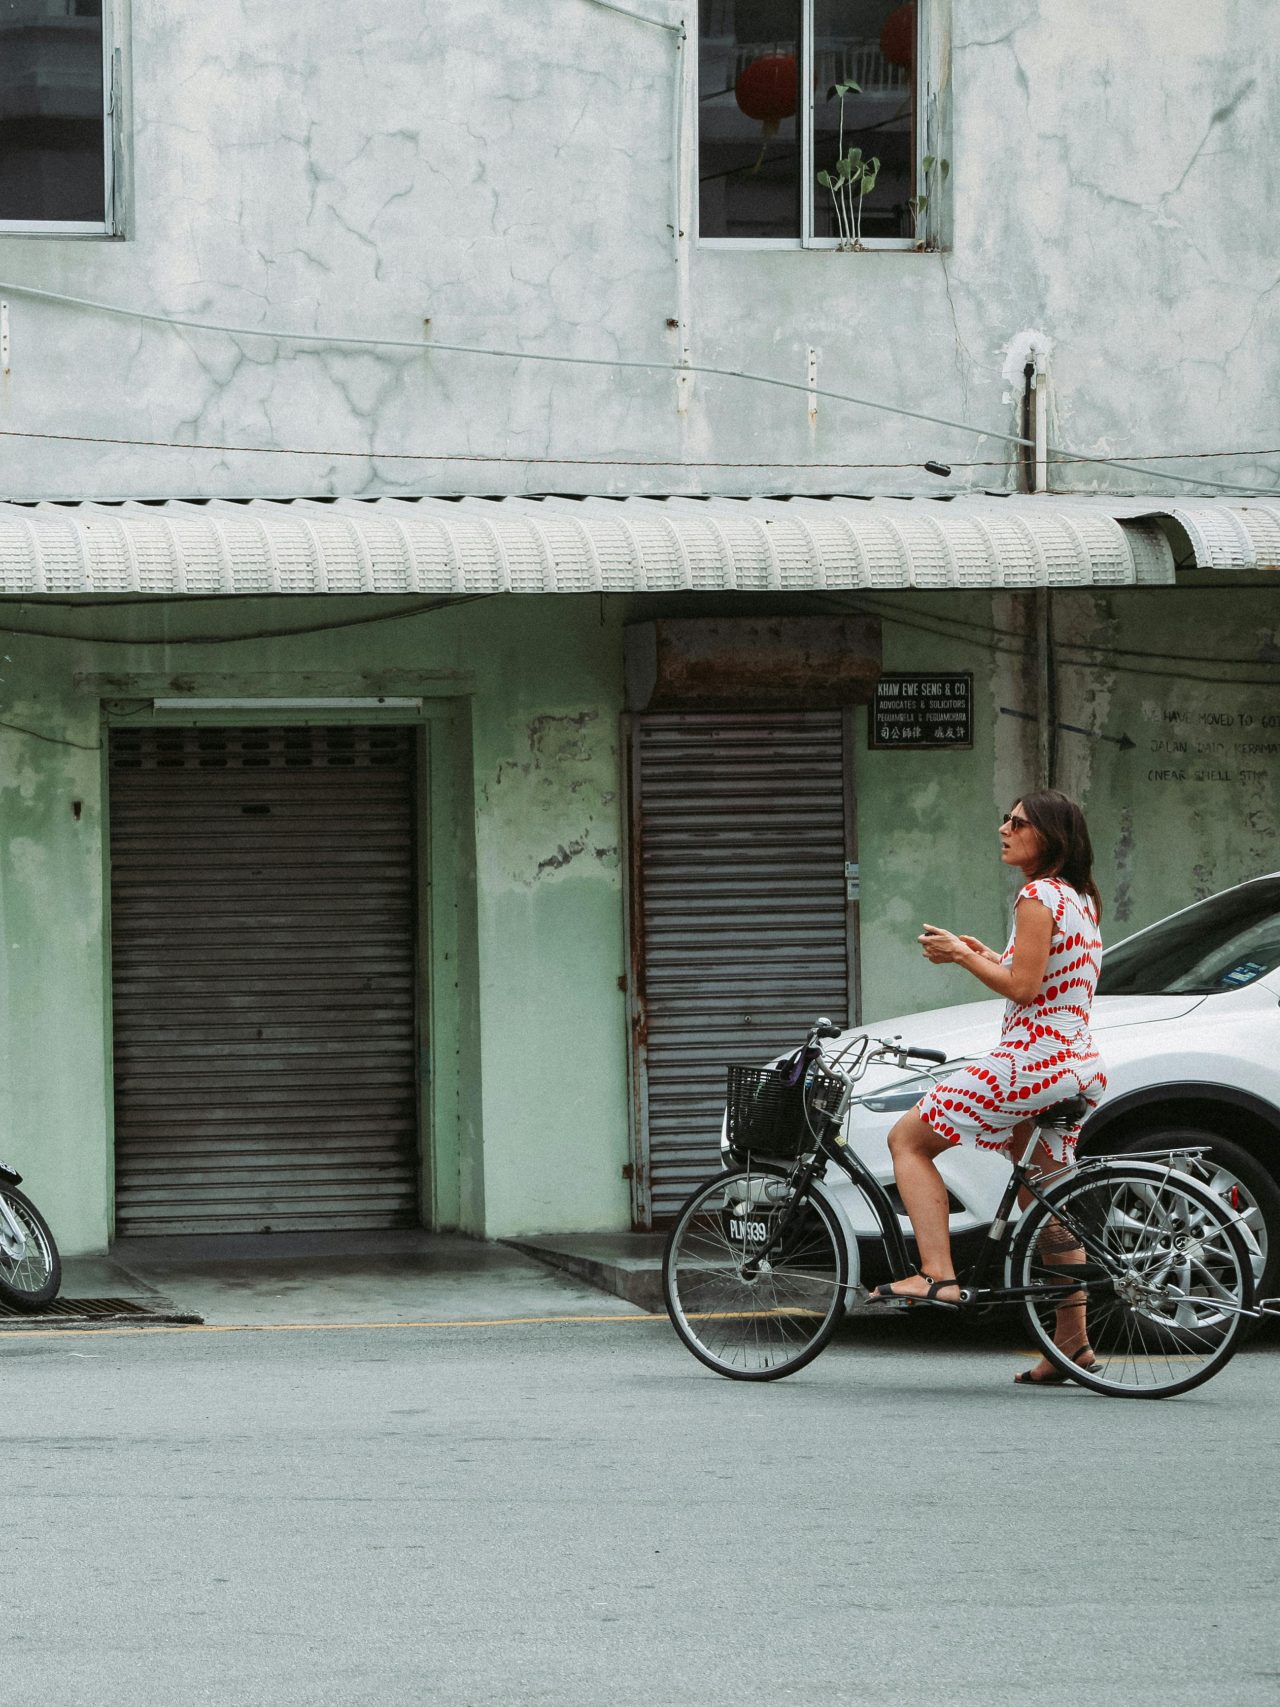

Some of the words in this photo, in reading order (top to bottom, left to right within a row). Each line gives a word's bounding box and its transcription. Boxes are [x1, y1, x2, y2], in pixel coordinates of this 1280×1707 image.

[878, 683, 900, 696] KHAW
[902, 683, 919, 696] EWE
[921, 683, 942, 696] SENG
[945, 683, 952, 696] &
[879, 700, 917, 709] ADVOCATES
[929, 699, 966, 709] SOLICITORS
